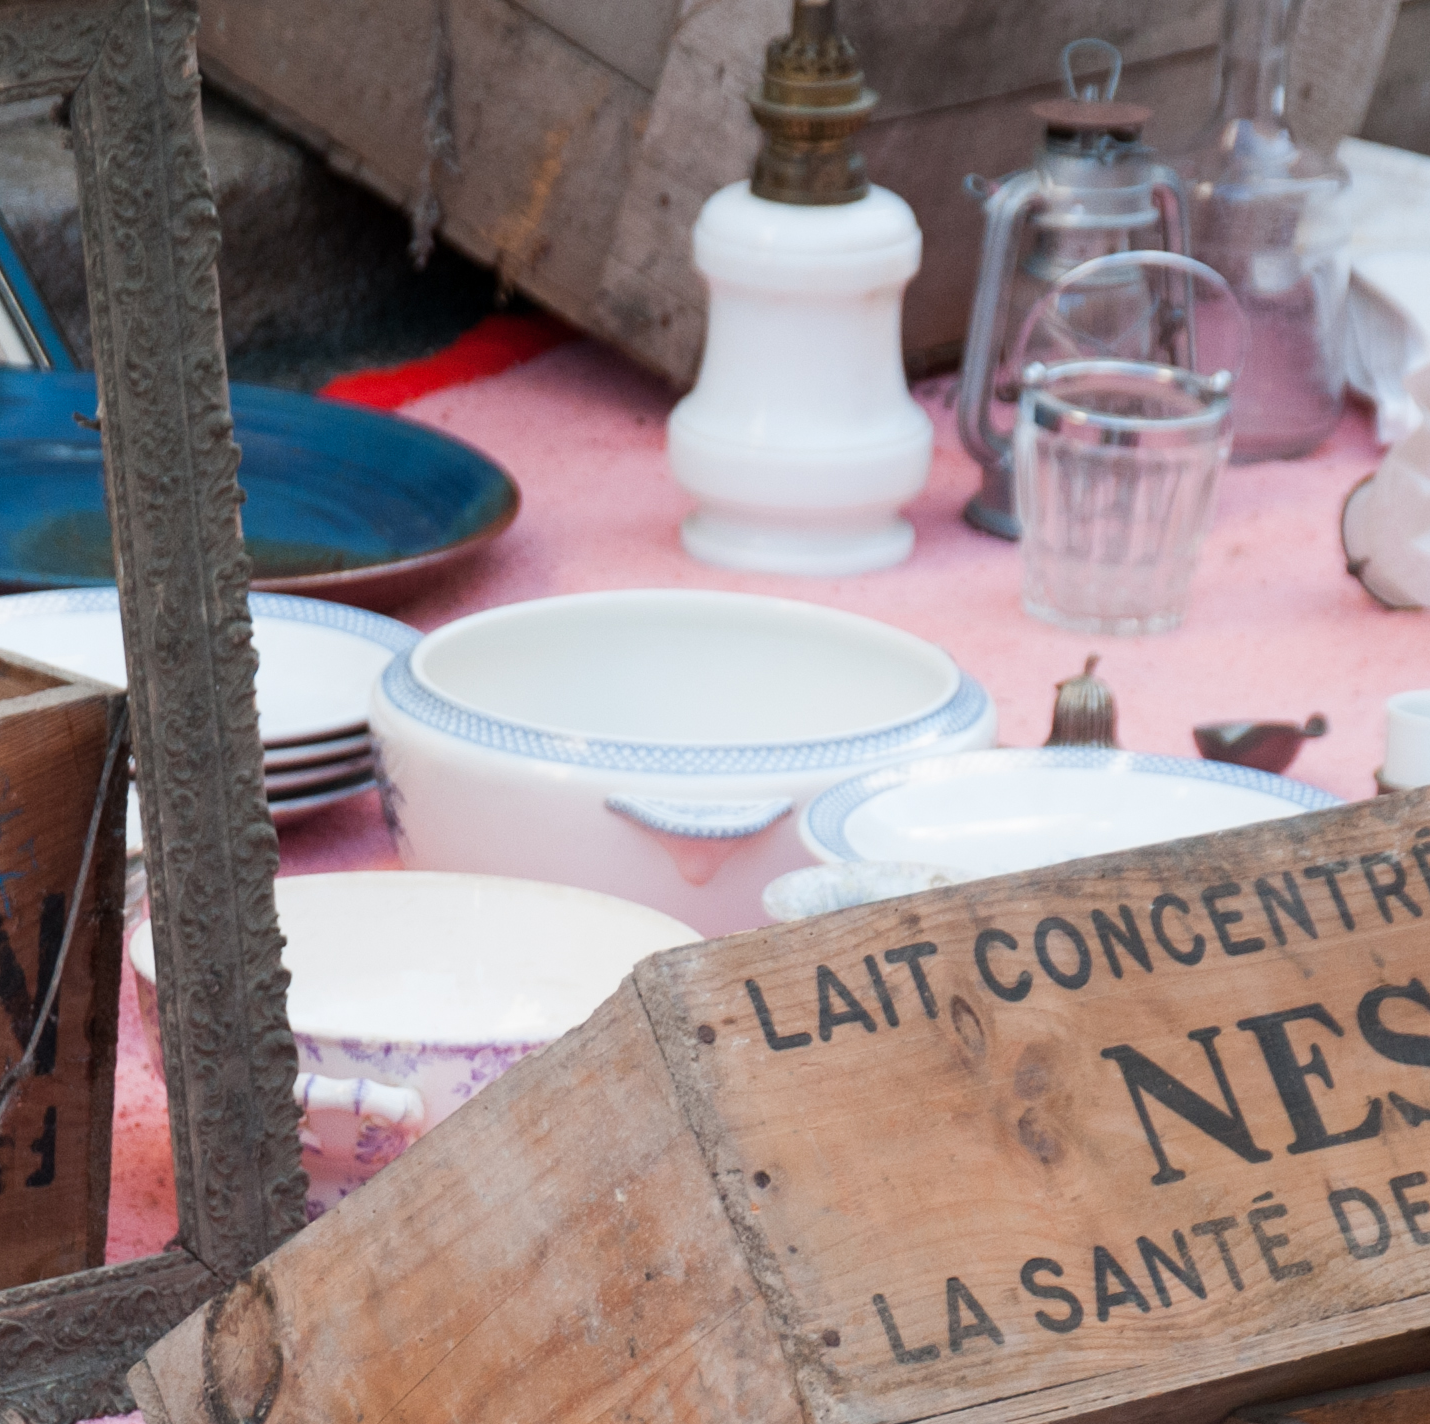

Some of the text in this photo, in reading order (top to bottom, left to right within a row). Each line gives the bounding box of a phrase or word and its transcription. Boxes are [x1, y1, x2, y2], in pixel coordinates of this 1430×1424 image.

[743, 940, 940, 1052] LAIT
[872, 1277, 1006, 1365] LA
[1018, 1190, 1316, 1335] SANTÉ
